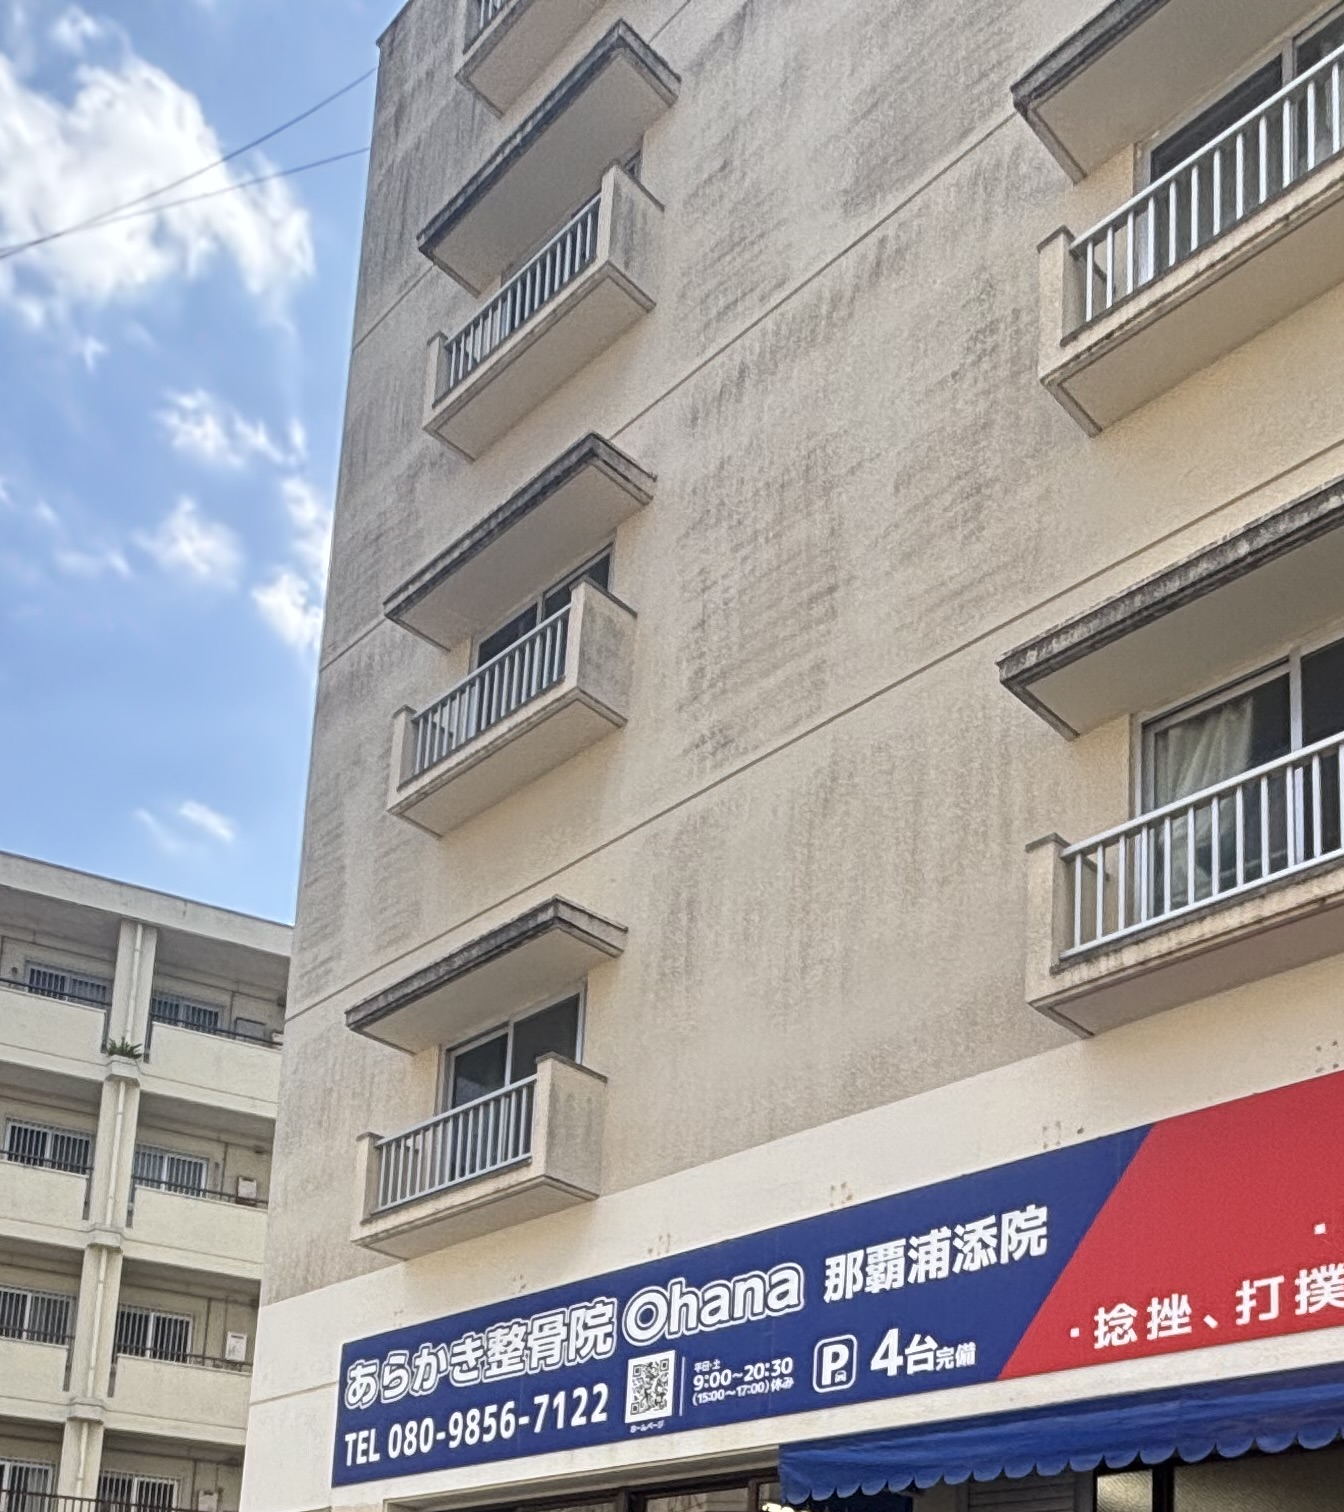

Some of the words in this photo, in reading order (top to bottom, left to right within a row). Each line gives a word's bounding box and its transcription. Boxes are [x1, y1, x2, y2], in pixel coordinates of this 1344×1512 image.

[345, 1297, 617, 1409] あらかき整骨院
[623, 1262, 804, 1346] Ohana
[823, 1205, 1047, 1302] 那覇浦添院
[345, 1429, 380, 1466] TEL
[388, 1382, 607, 1459] 080-9856-7122
